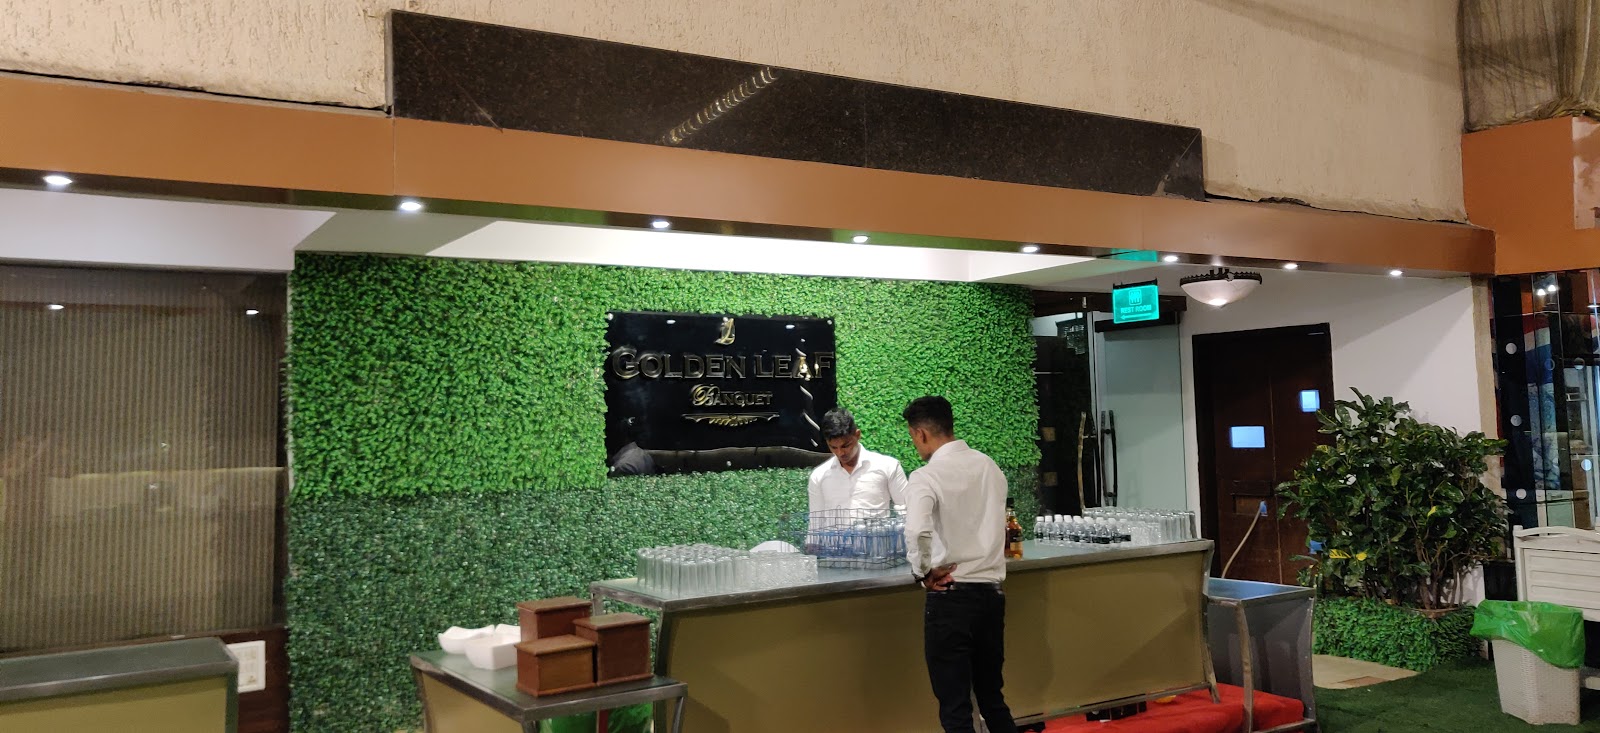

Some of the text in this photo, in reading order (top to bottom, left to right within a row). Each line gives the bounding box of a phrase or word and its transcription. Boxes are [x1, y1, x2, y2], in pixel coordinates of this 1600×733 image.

[1120, 304, 1152, 314] REST ROOM
[611, 346, 835, 381] GOLDEN LEAF
[690, 383, 774, 407] BANQUET
